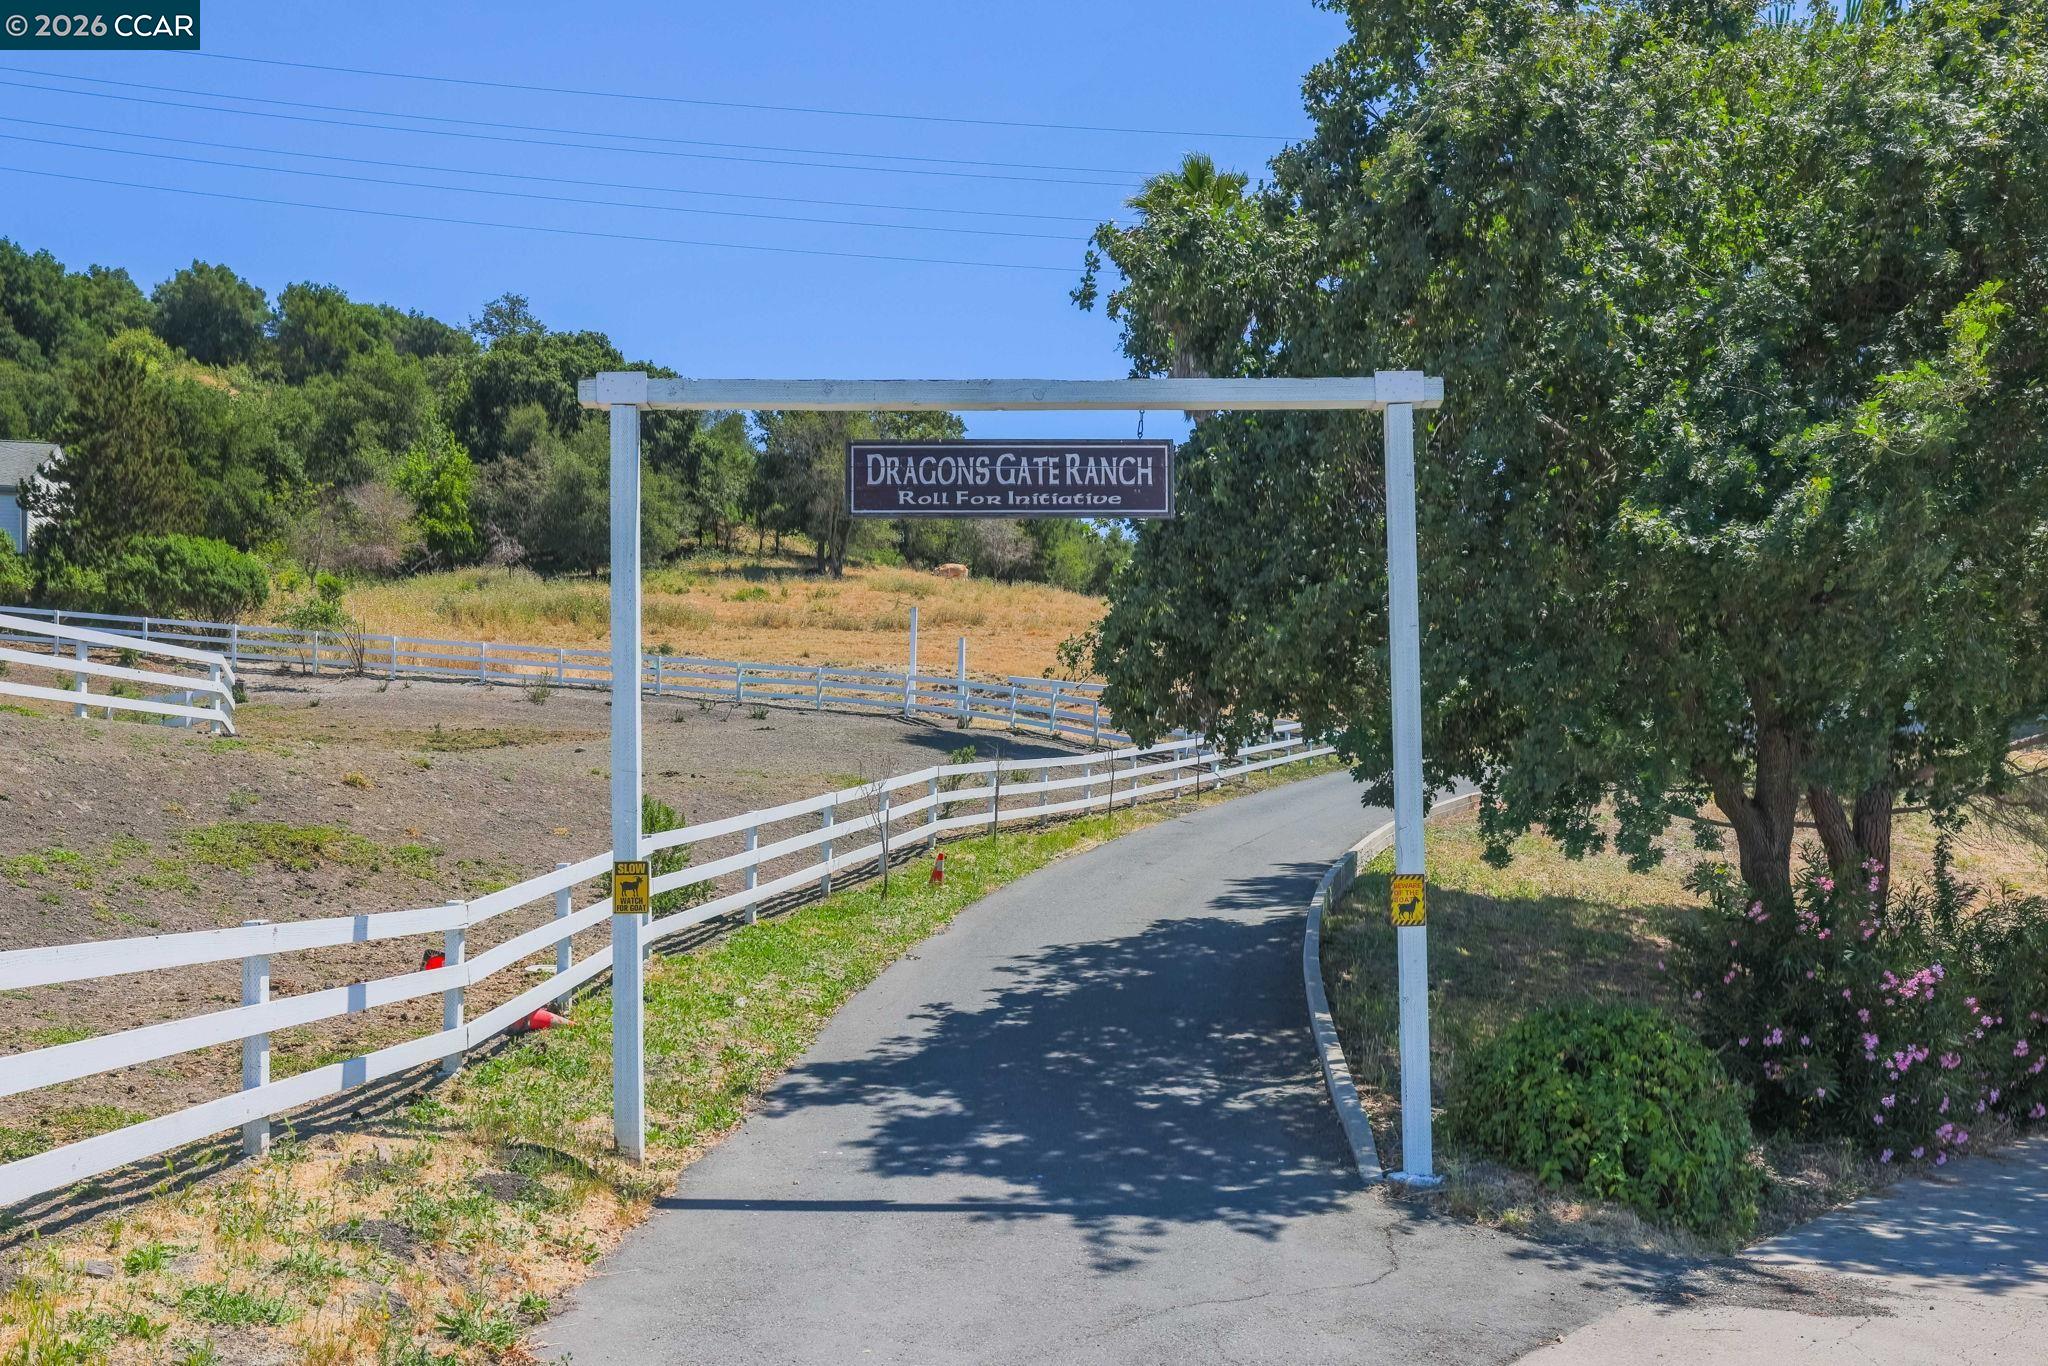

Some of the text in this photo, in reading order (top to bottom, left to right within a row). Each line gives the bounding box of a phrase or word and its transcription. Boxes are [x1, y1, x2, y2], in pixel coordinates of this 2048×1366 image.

[866, 452, 1153, 486] DRAGONS GATE RANCH
[897, 490, 949, 505] Roll
[1007, 490, 1122, 505] Initiative
[617, 864, 645, 874] SLOW
